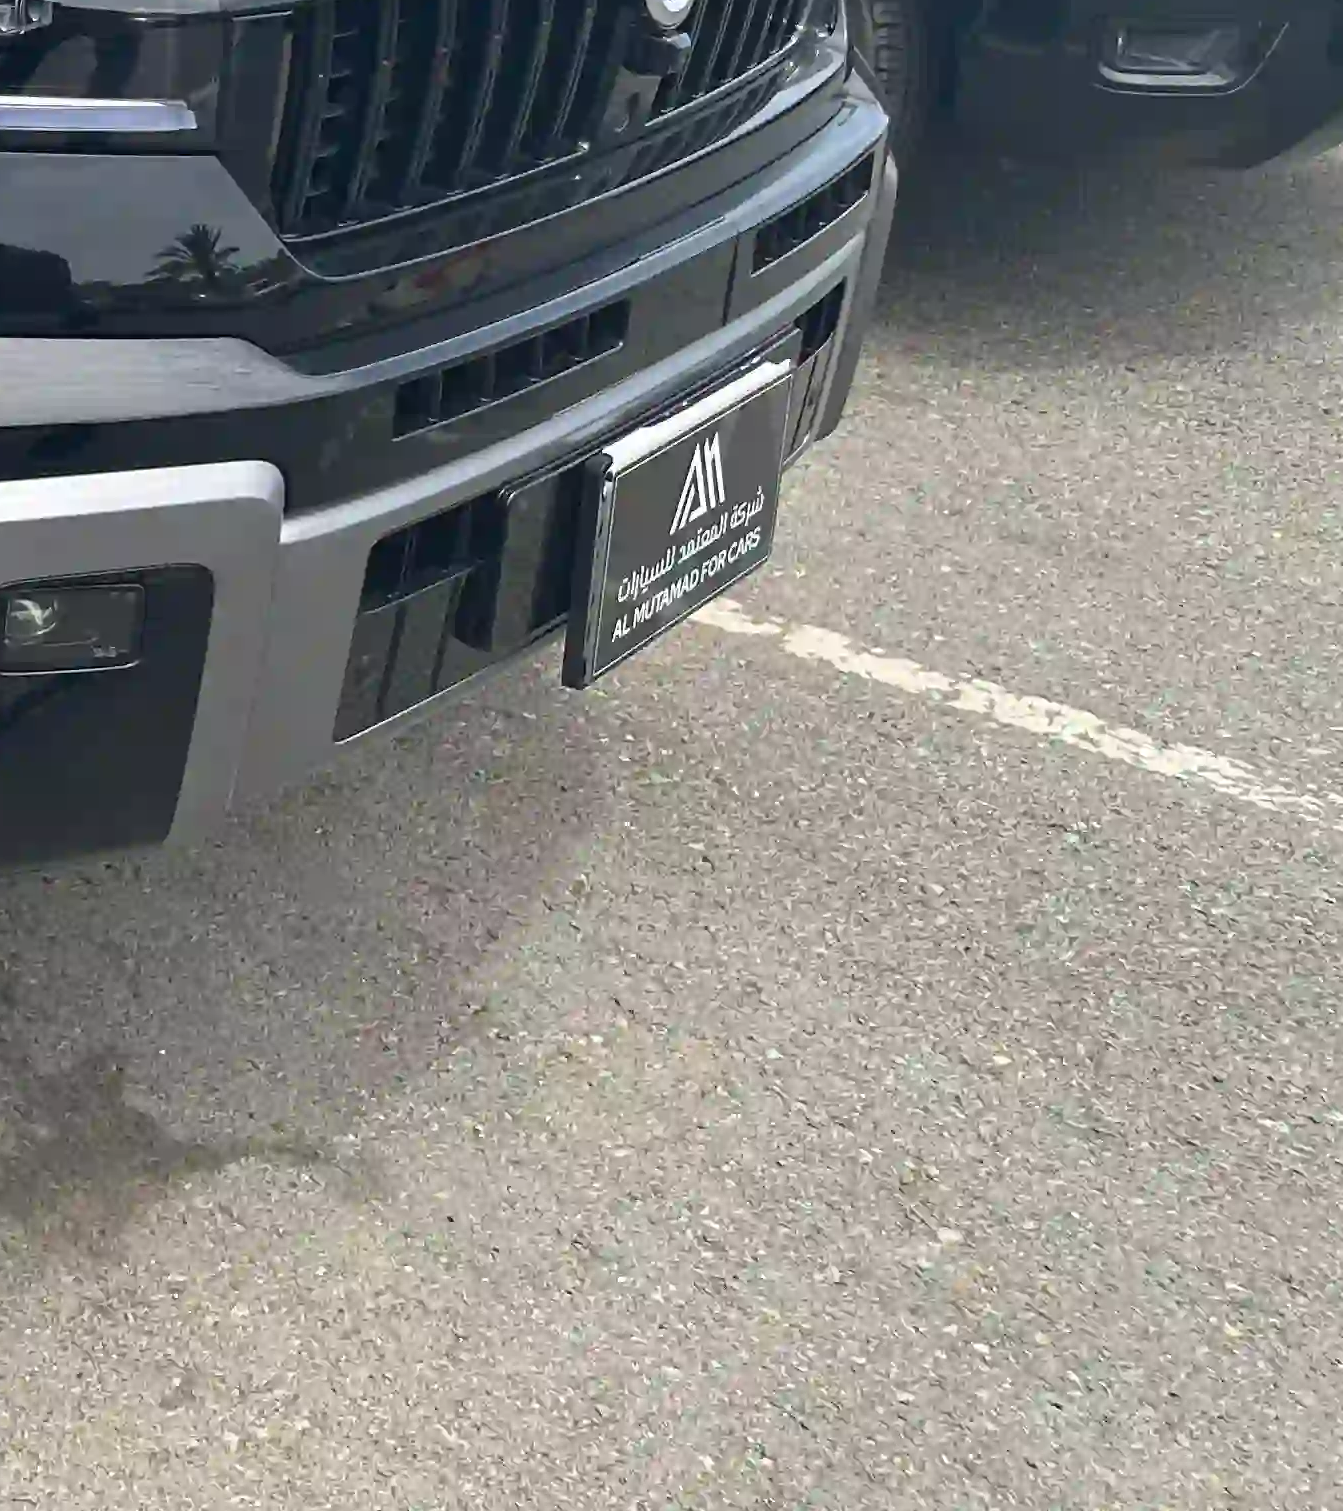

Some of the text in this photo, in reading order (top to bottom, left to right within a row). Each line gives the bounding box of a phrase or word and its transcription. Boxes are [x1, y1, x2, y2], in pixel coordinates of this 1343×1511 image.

[611, 525, 761, 643] AL MUTAMAD FOR CARS
[616, 485, 765, 603] شركة المعتمد للسيارات
